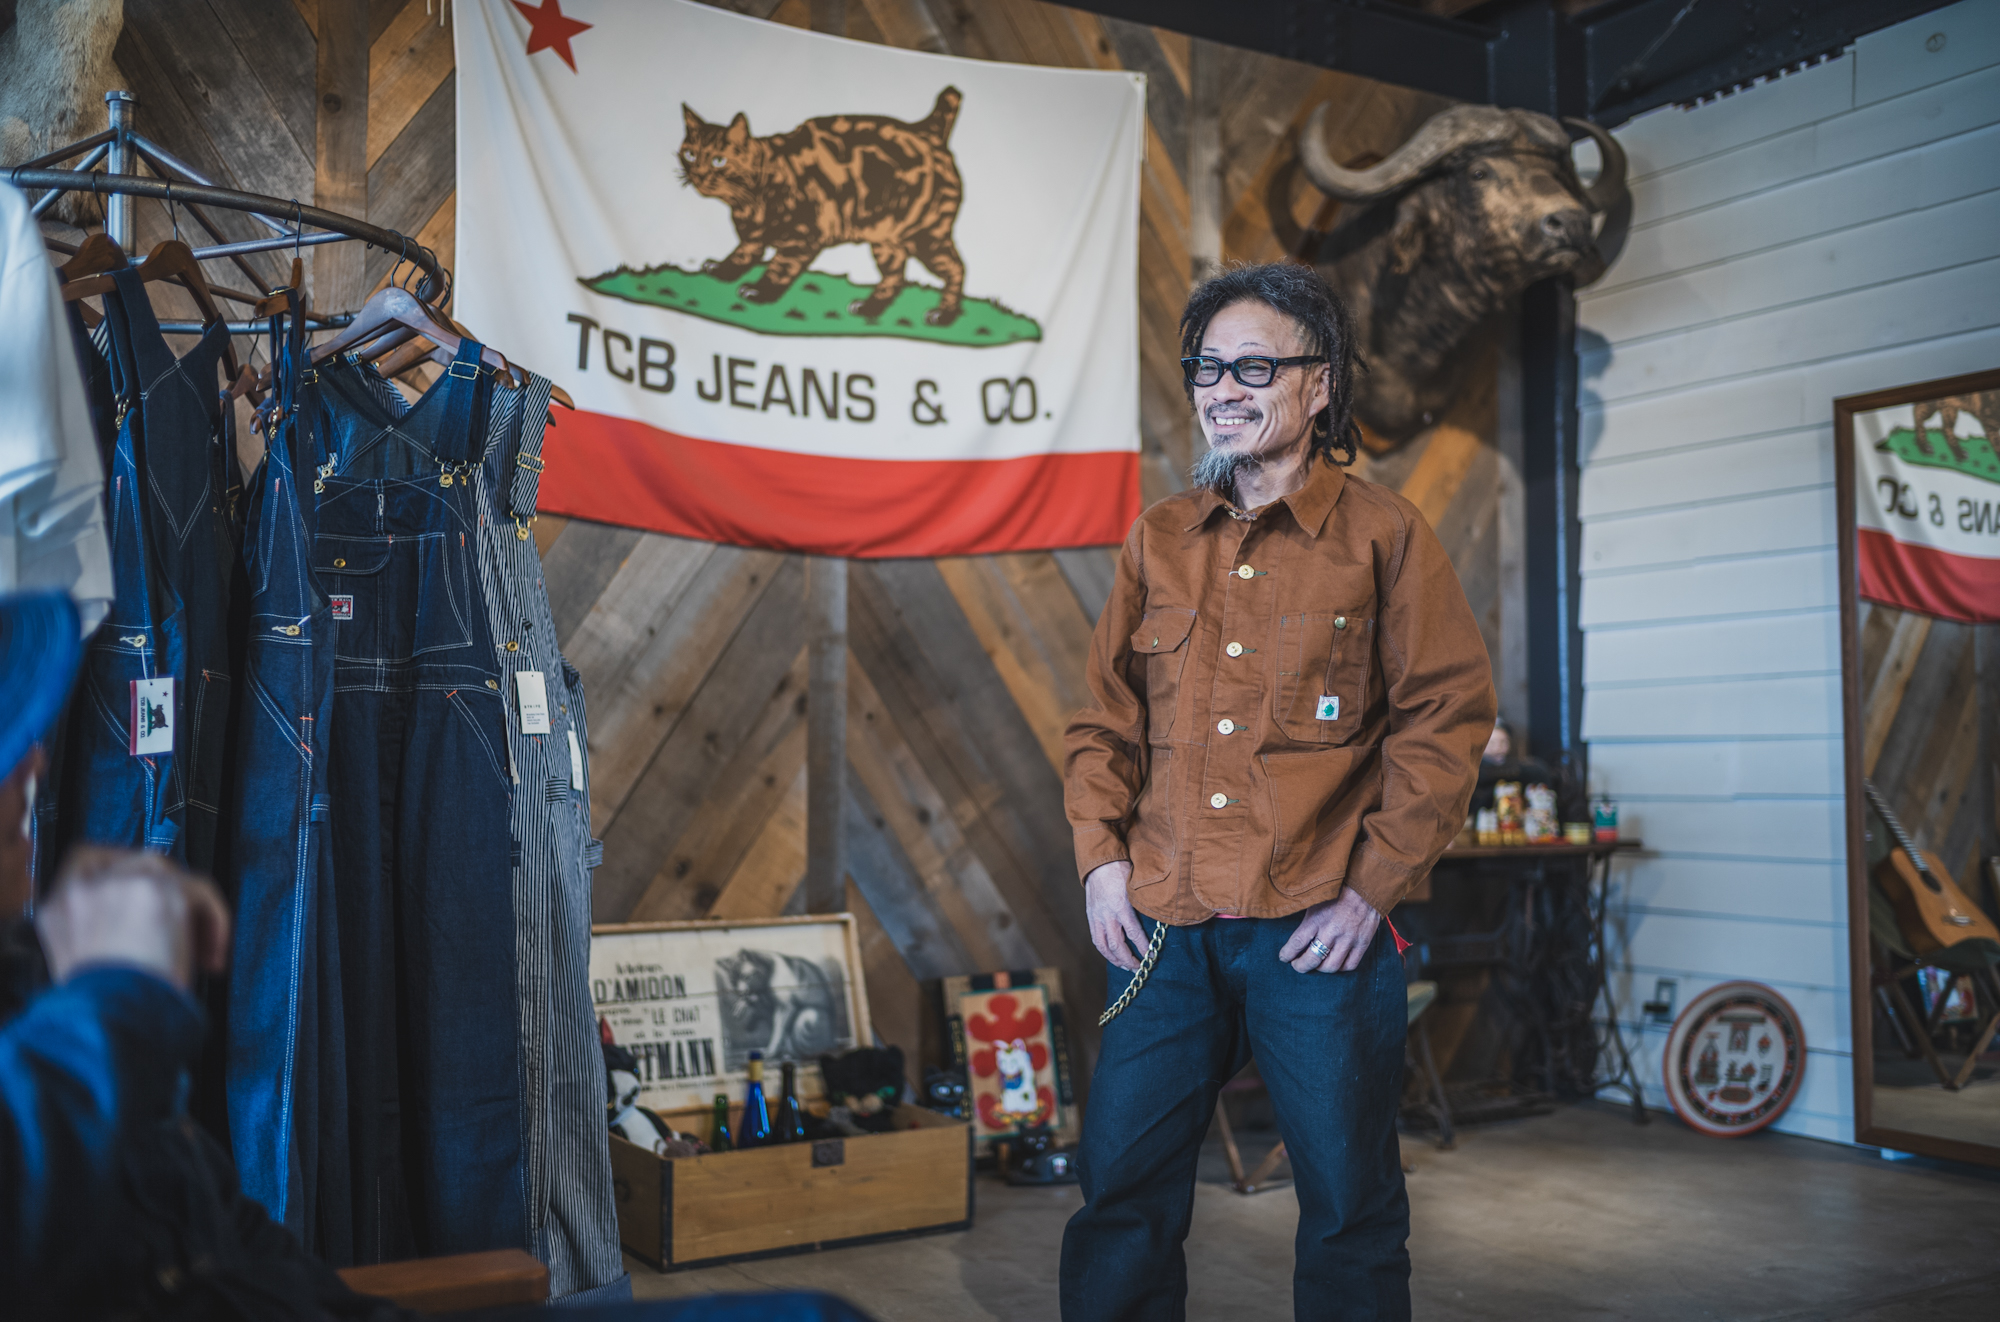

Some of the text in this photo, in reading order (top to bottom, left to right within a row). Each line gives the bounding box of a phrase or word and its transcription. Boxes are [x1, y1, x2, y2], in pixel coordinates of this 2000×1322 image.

[566, 312, 1052, 426] TCB JEANS & CO.
[593, 975, 687, 1004] D'AMIDON
